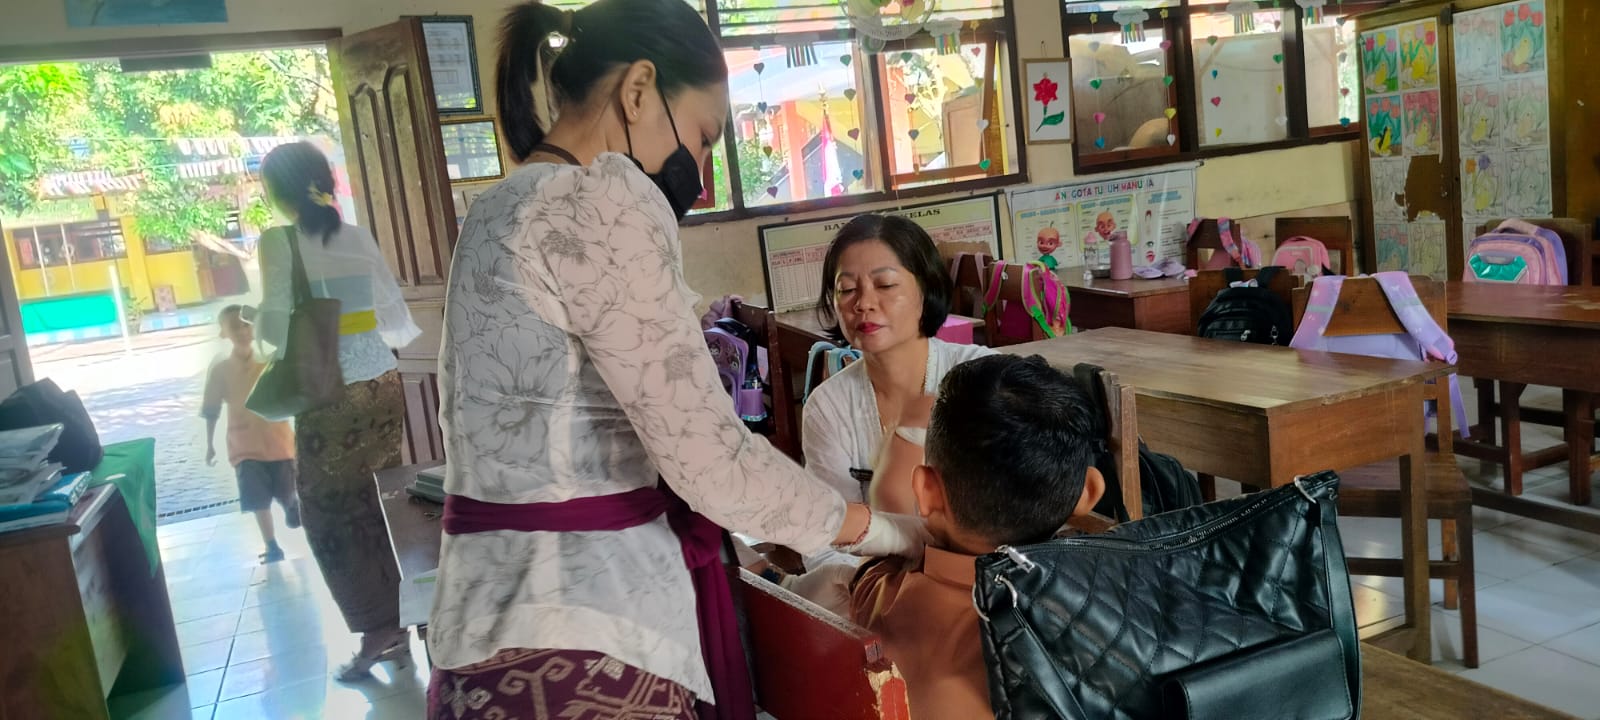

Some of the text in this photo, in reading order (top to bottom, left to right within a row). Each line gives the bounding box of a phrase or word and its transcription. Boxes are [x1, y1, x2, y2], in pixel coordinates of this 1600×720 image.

[1055, 178, 1154, 201] ANGOTA TUUH MANUIA
